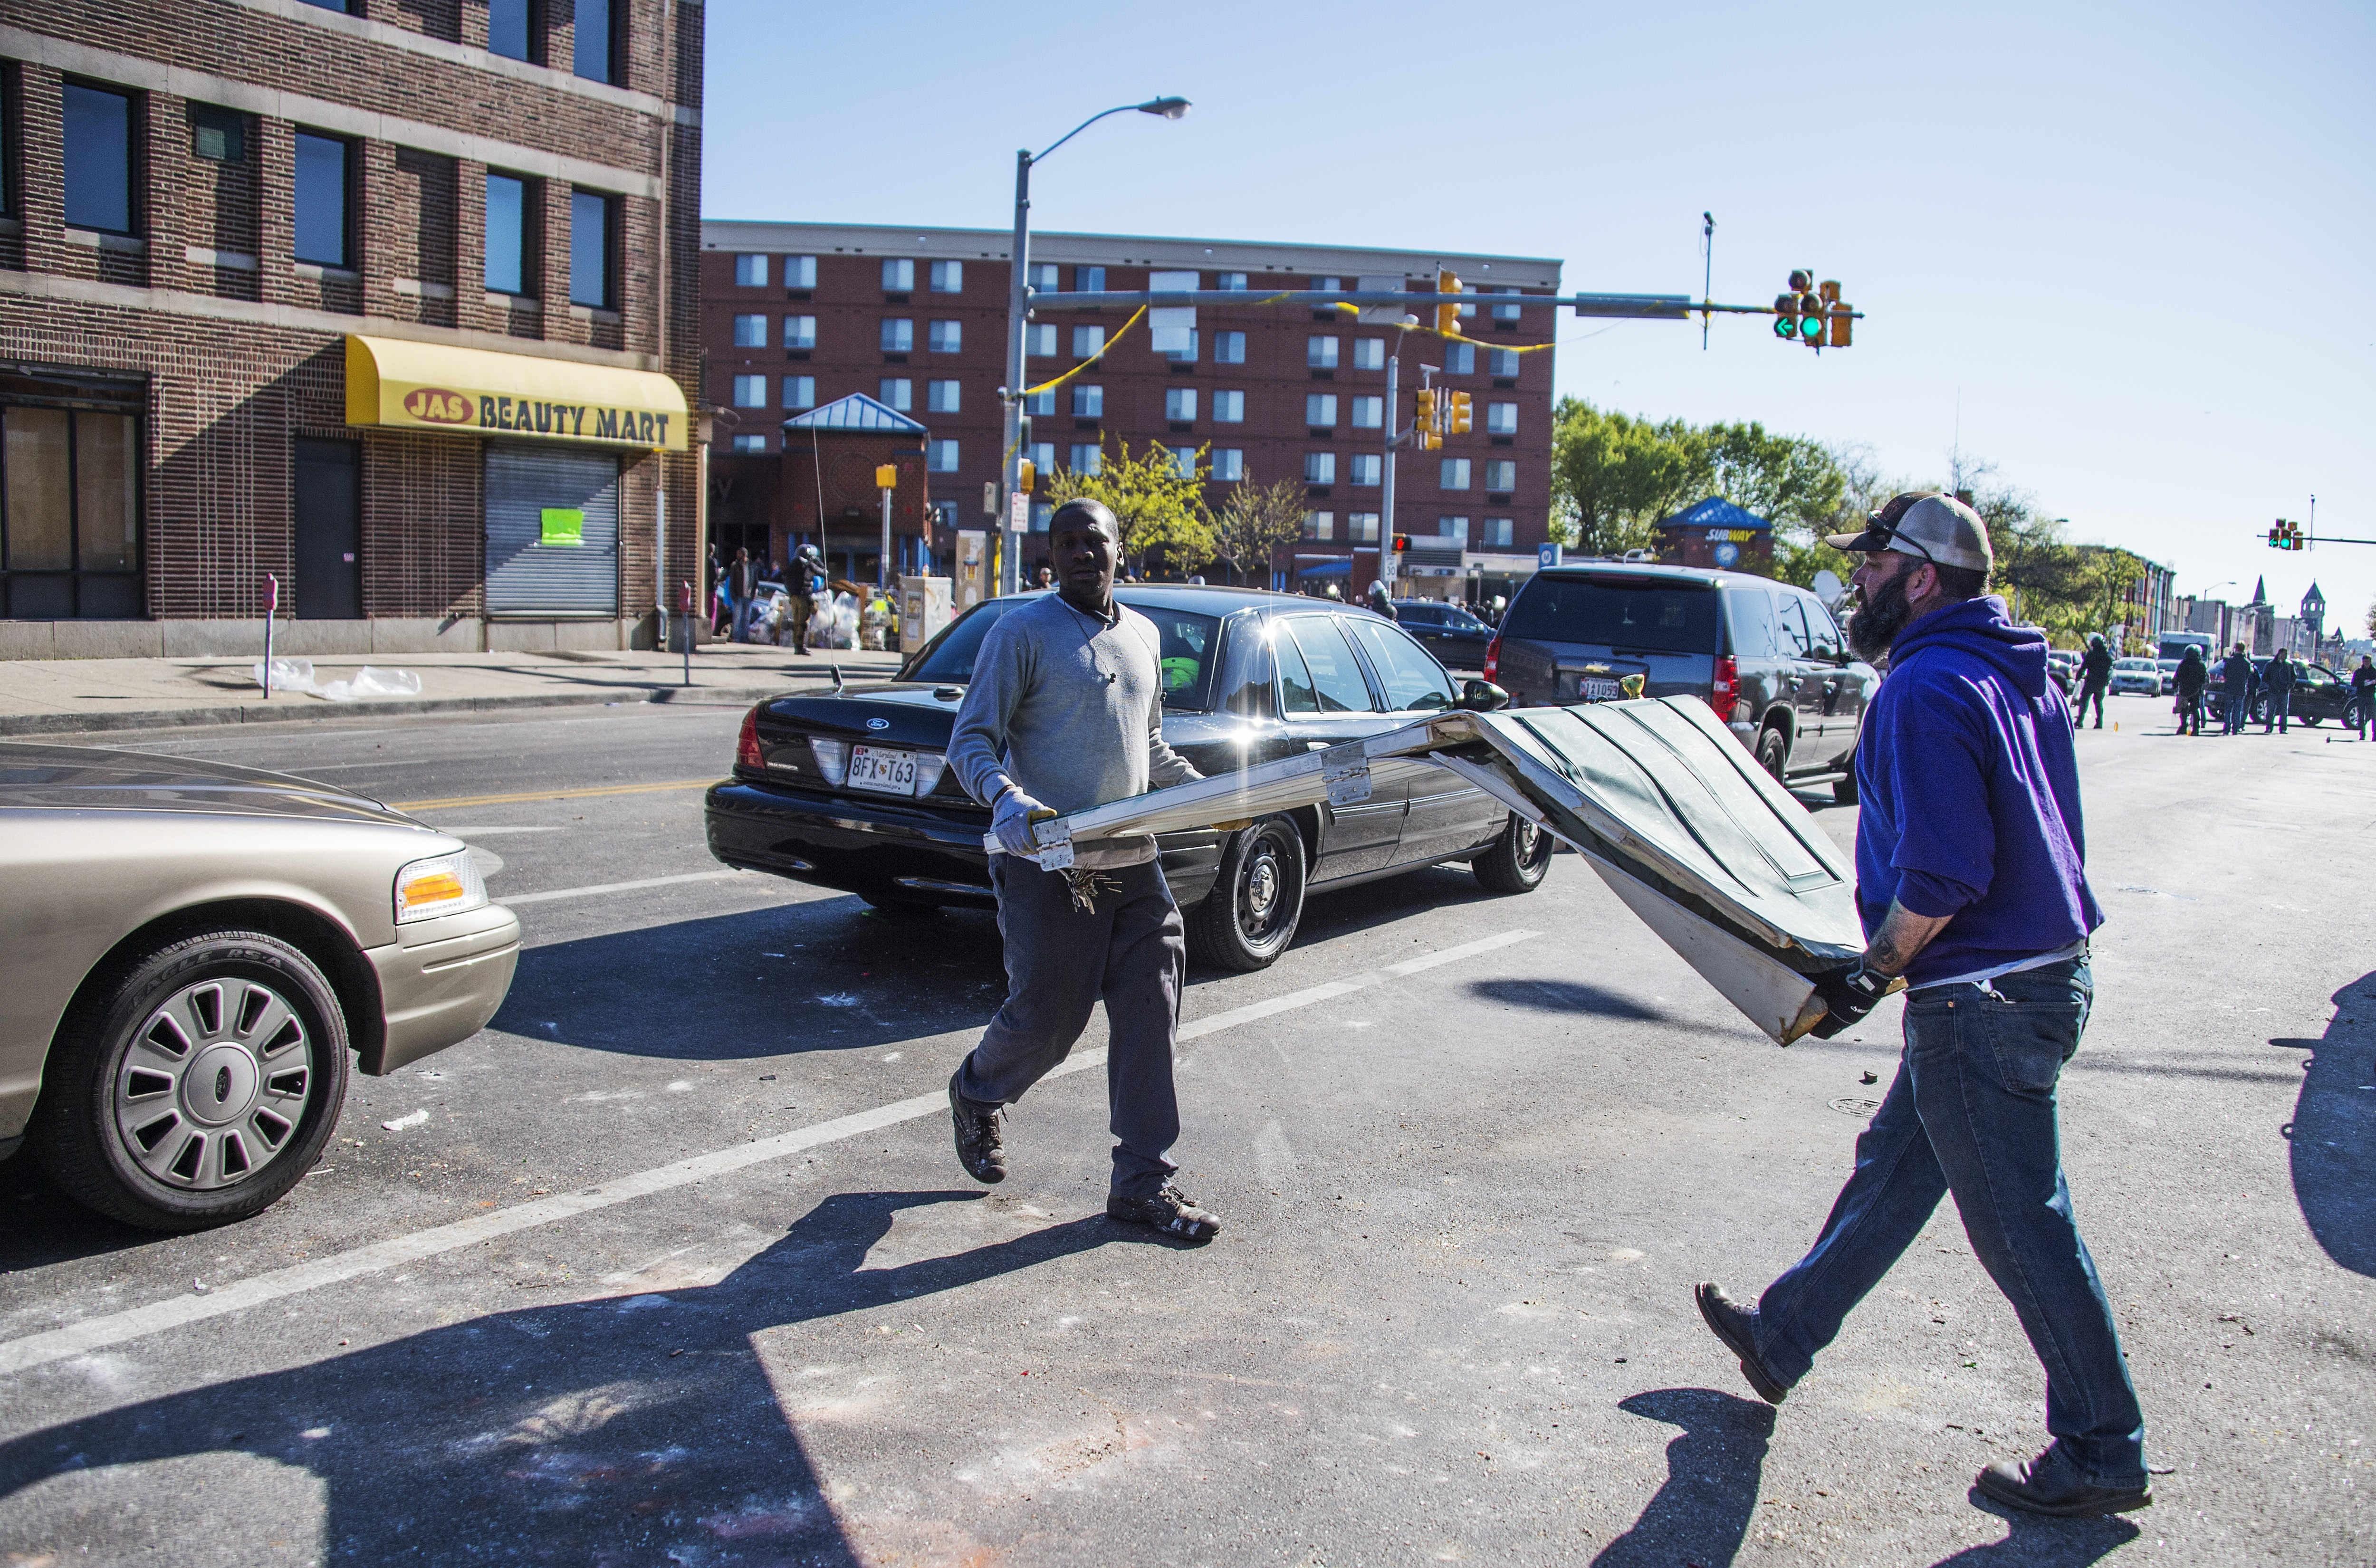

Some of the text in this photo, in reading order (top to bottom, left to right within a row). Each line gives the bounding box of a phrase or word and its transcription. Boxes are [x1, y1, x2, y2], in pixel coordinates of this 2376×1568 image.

[410, 392, 669, 444] JAS BEAUTY MART
[1705, 528, 1756, 542] SUBWAY
[1387, 566, 1396, 575] 30
[852, 757, 914, 784] 8FX T63
